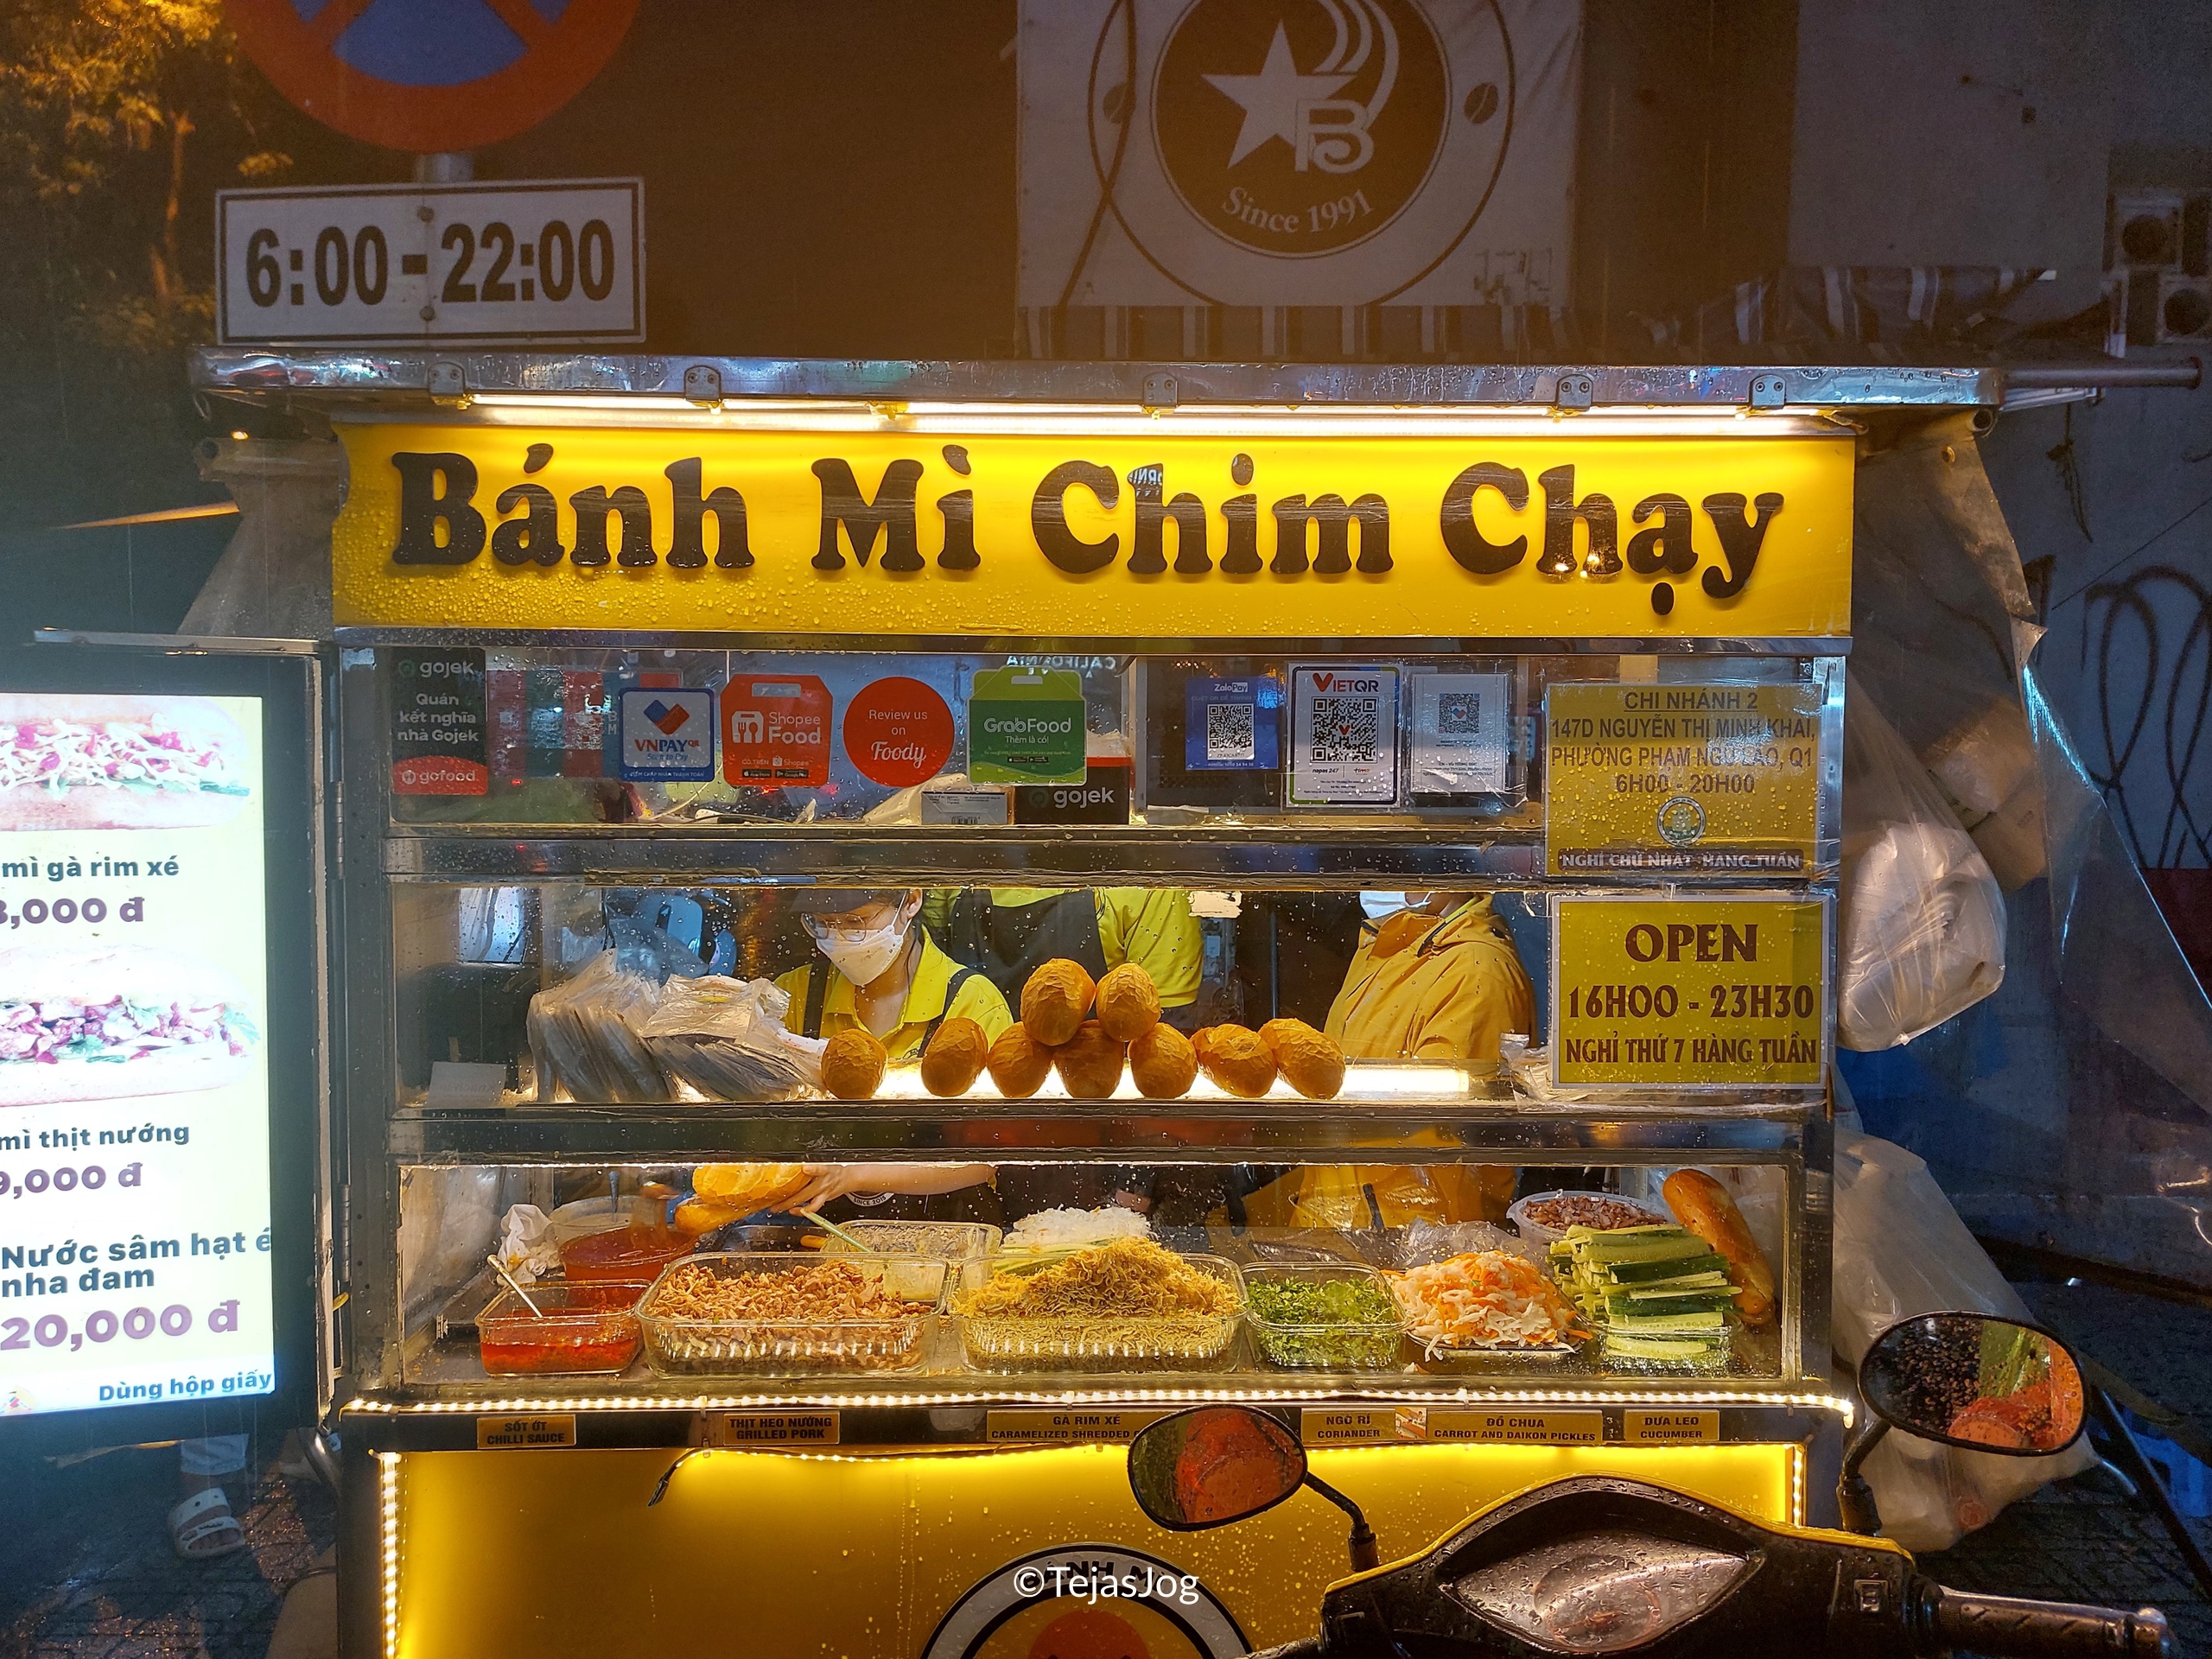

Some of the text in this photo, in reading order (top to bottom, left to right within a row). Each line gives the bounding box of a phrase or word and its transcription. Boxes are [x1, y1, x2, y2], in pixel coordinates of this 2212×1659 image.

[1221, 186, 1374, 234] Since 1991
[391, 442, 1785, 617] Bánh Mì Chim Chạy
[419, 660, 475, 678] gojek
[1214, 681, 1249, 692] ZaloPay
[1312, 671, 1380, 693] VIETQR
[416, 692, 460, 706] Quán
[1624, 688, 1758, 709] CHI NHÁNH 2
[399, 709, 477, 727] kết nghĩa
[768, 711, 821, 728] Shopee
[868, 709, 928, 720] Review us
[891, 727, 906, 735] on
[983, 717, 1072, 733] GrabFood
[1552, 718, 1594, 738] 147D
[1599, 714, 1676, 738] NGUYỄN
[1681, 717, 1711, 742] THỊ
[1715, 717, 1761, 738] MINH
[397, 728, 480, 745] nhà Gojek
[768, 726, 821, 745] Food
[1005, 734, 1050, 743] Thèm là có!
[784, 758, 810, 767] Shopee
[870, 741, 927, 769] Foody
[1551, 742, 1633, 766] PHƯỜNG
[1638, 746, 1691, 771] PHẠM
[1789, 746, 1812, 768] Q1
[419, 769, 476, 785] gofood
[1616, 773, 1669, 793] 6H00
[1689, 773, 1755, 793] 20H00
[1052, 786, 1116, 810] gojek
[2, 855, 180, 882] mì gà rim xé
[119, 896, 145, 923] đ
[1624, 923, 1759, 963] OPEN
[1709, 983, 1815, 1019] 23H30
[1565, 1030, 1817, 1064] NGHỈ THỨ 7 HÀNG TUẦN
[0, 1122, 190, 1152] mì thịt nướng
[118, 1161, 143, 1188] đ
[872, 1195, 887, 1205] 2015
[2, 1238, 99, 1269] Nước
[108, 1234, 181, 1262] sâm
[190, 1231, 246, 1261] hạt
[2, 1267, 155, 1298] nha đam
[0, 1299, 241, 1353] 20,000 đ
[99, 1369, 273, 1402] Dùng hộp giấy
[728, 1415, 833, 1430] THỊT HEO NƯỚNG
[1052, 1414, 1122, 1426] GÀ RIM XÉ
[1509, 1418, 1546, 1428] CHUA
[1675, 1416, 1700, 1426] LEO
[486, 1432, 566, 1446] CHILLI SAUCE
[735, 1428, 826, 1440] GRILLED PORK
[991, 1429, 1069, 1440] CARAMELIZED
[1071, 1429, 1131, 1440] SHREDDED
[1317, 1428, 1381, 1439] CORIANDER
[1433, 1429, 1597, 1441] CARROT AND DAIKON PICKLES
[1640, 1430, 1703, 1439] CUCUMBER
